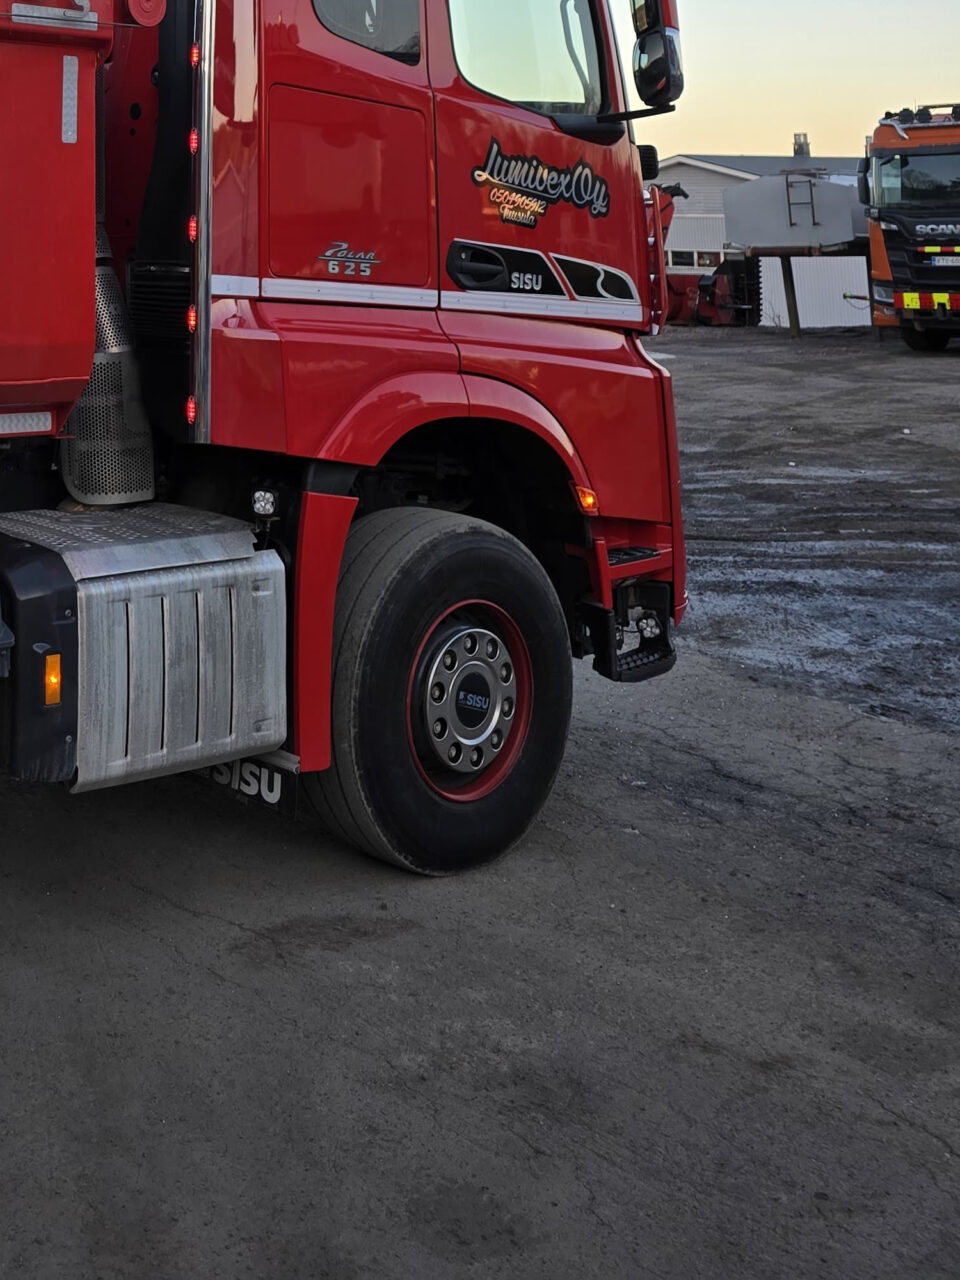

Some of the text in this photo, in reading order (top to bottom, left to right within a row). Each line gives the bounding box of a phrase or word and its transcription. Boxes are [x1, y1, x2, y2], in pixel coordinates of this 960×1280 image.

[328, 261, 371, 276] 625
[511, 271, 542, 291] SISU
[466, 693, 489, 709] SISU
